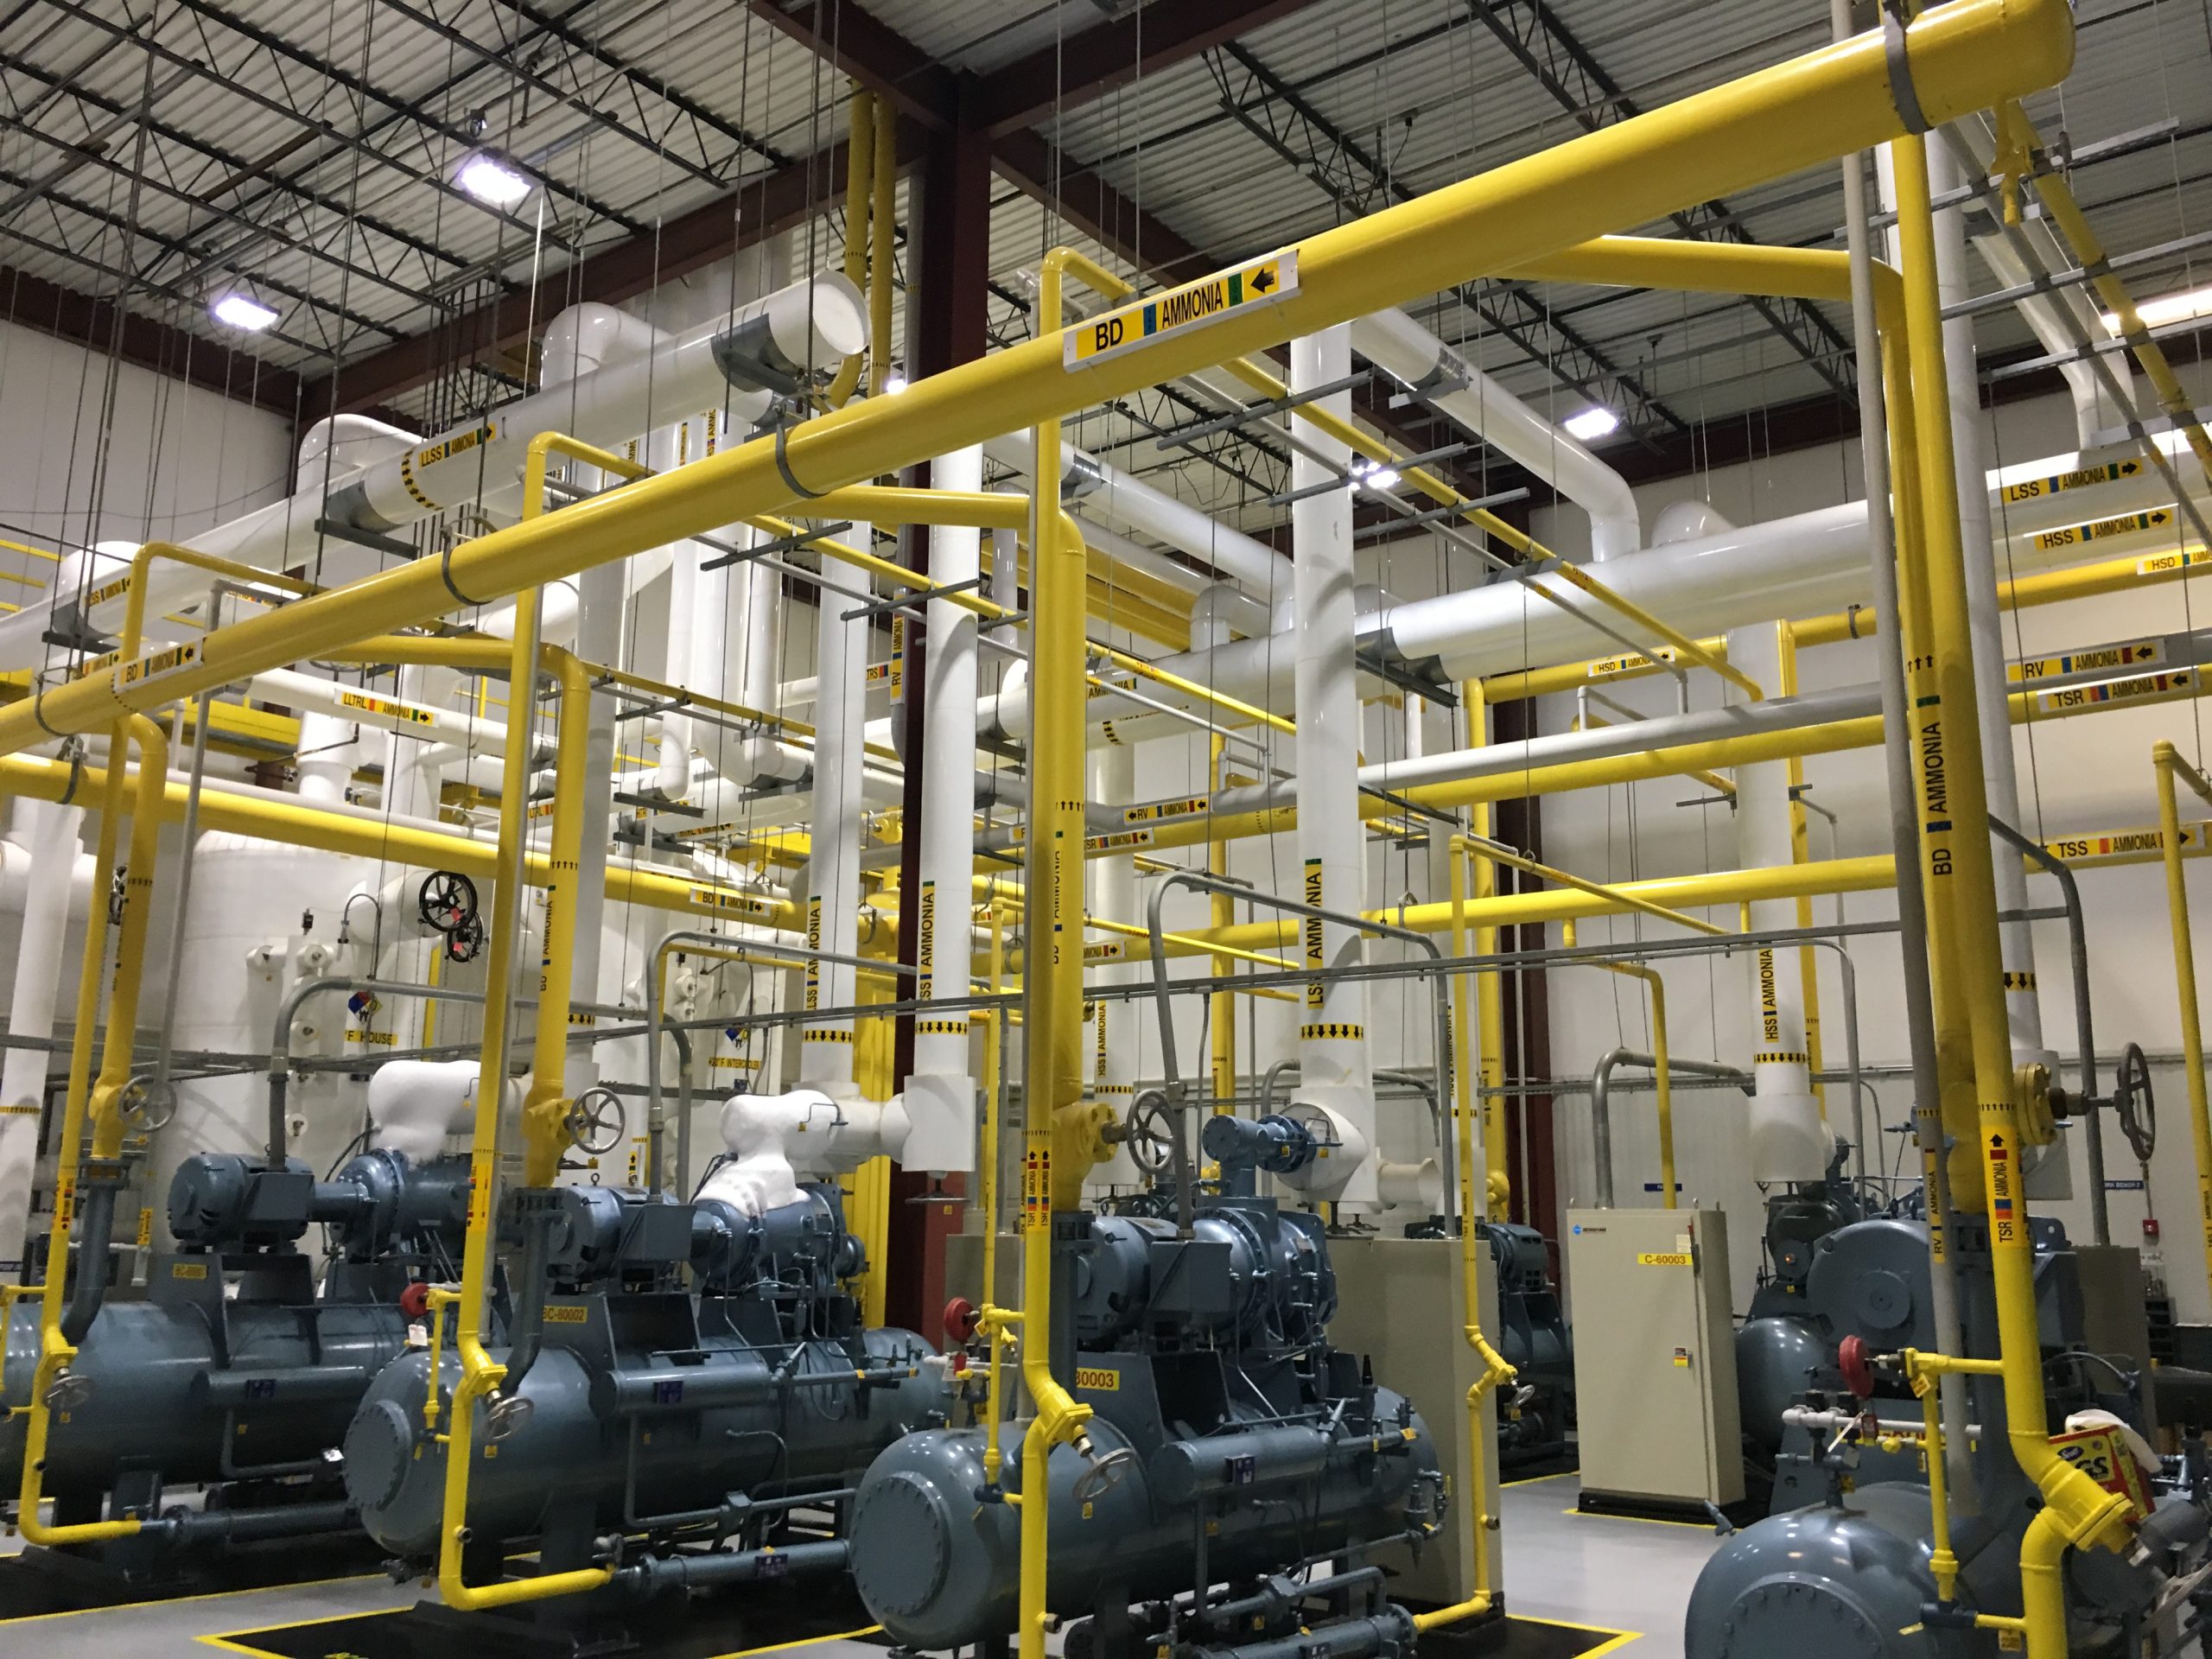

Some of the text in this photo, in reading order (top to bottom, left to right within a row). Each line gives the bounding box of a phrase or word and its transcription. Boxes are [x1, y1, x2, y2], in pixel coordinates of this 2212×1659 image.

[1096, 317, 1123, 352] BD
[1161, 281, 1224, 329] AMMONIA
[421, 430, 475, 467] LLSS AMMONIA
[2010, 467, 2106, 501] LSS AMMONIA
[2042, 518, 2137, 549] HSS AMMONIA
[2152, 556, 2176, 570] HSD
[126, 648, 175, 683] BD AMMONIA
[891, 619, 904, 685] RV AMMONIA
[1599, 662, 1616, 672] HSD
[2024, 651, 2120, 678] RV AMMONIA
[344, 692, 411, 720] LLTRL AMMONIA
[2054, 680, 2155, 708] TSR AMMONIA
[1137, 801, 1188, 820] RV AMMONIA
[1922, 721, 1953, 876] BD AMMONIA
[2057, 833, 2158, 858] TSS AMMONIA
[702, 893, 748, 910] BD AMMONIA
[919, 892, 935, 968] AMMONIA
[1759, 949, 1778, 1039] HSS AMMONIA
[359, 1031, 393, 1046] HOUSE
[1097, 1004, 1106, 1077] HSS AMMONIA
[1928, 1171, 1943, 1255] RV AMMONIA
[1993, 1161, 2014, 1243] TSR AMMONIA
[1027, 1212, 1036, 1228] TSR
[1644, 1255, 1686, 1264] C-60003
